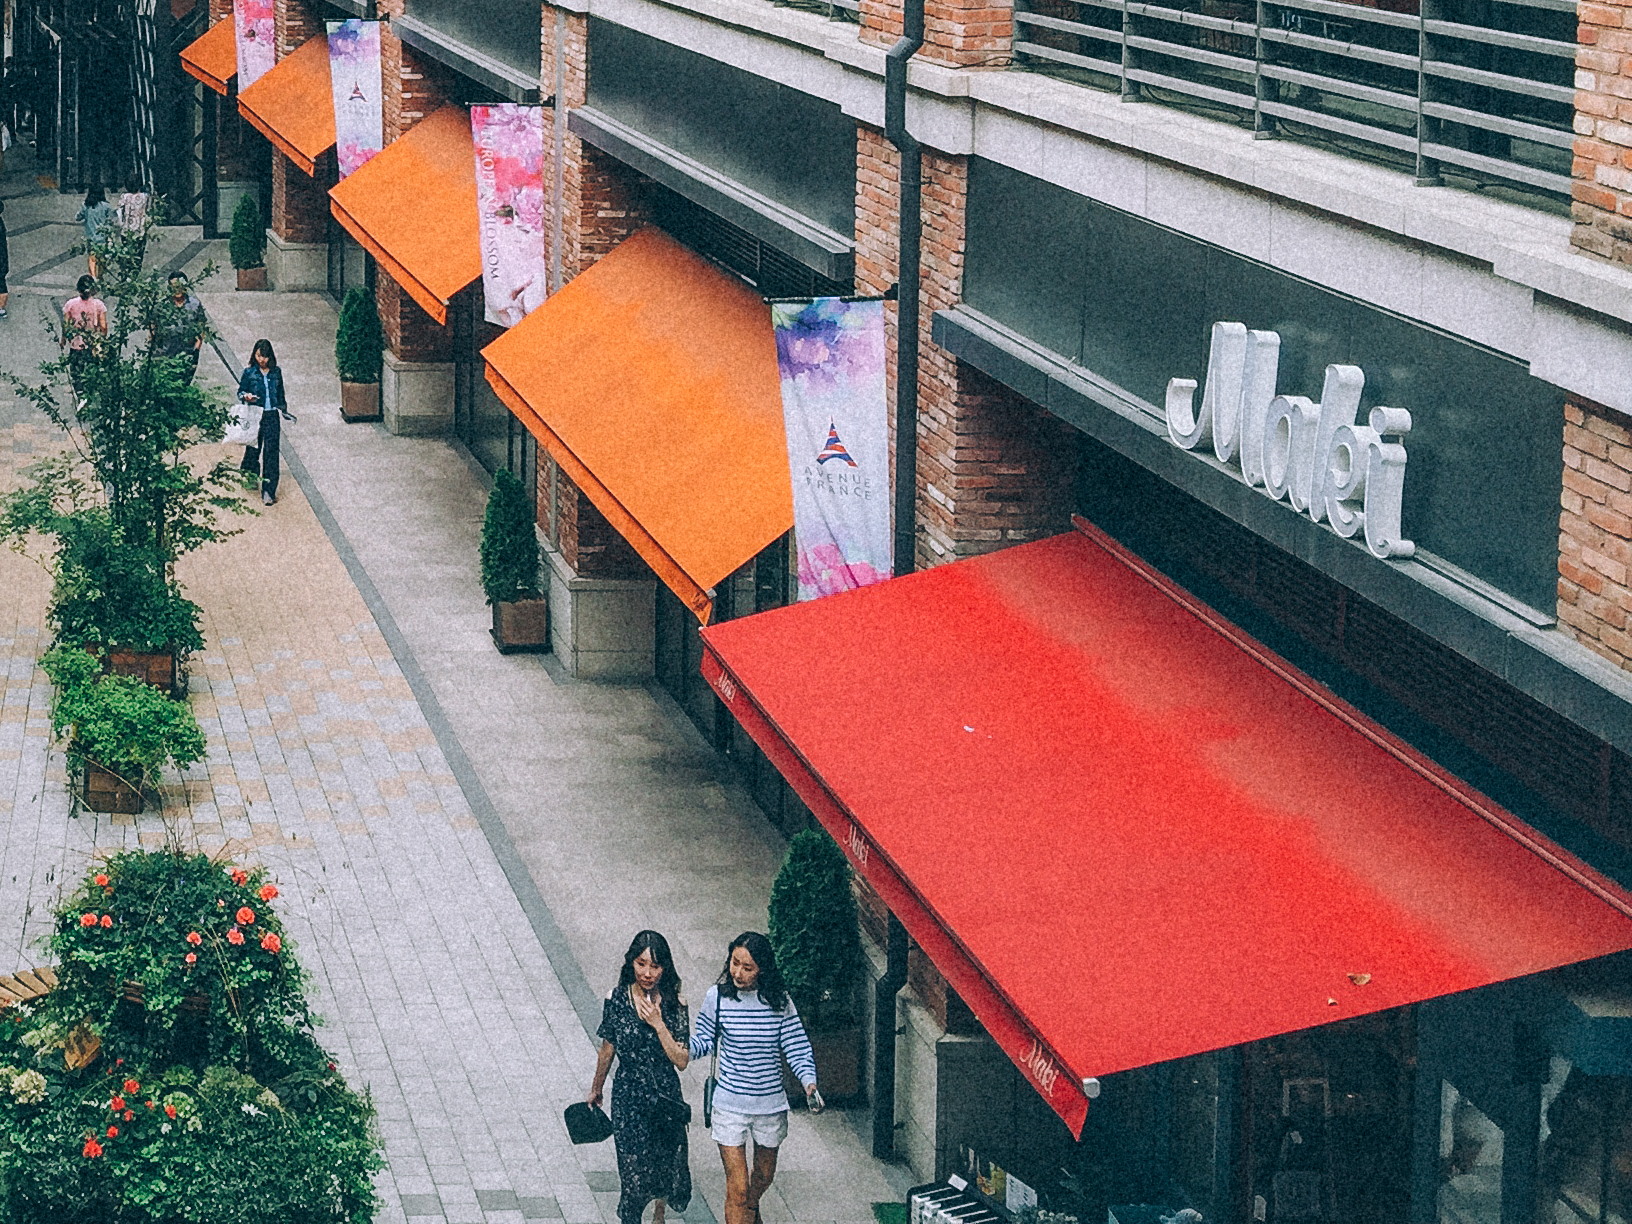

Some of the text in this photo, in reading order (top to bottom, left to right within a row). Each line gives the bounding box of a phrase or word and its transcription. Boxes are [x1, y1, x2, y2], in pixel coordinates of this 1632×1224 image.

[484, 213, 500, 279] BLOSSOM
[805, 466, 871, 488] AVENUE
[806, 477, 872, 501] FRANCE
